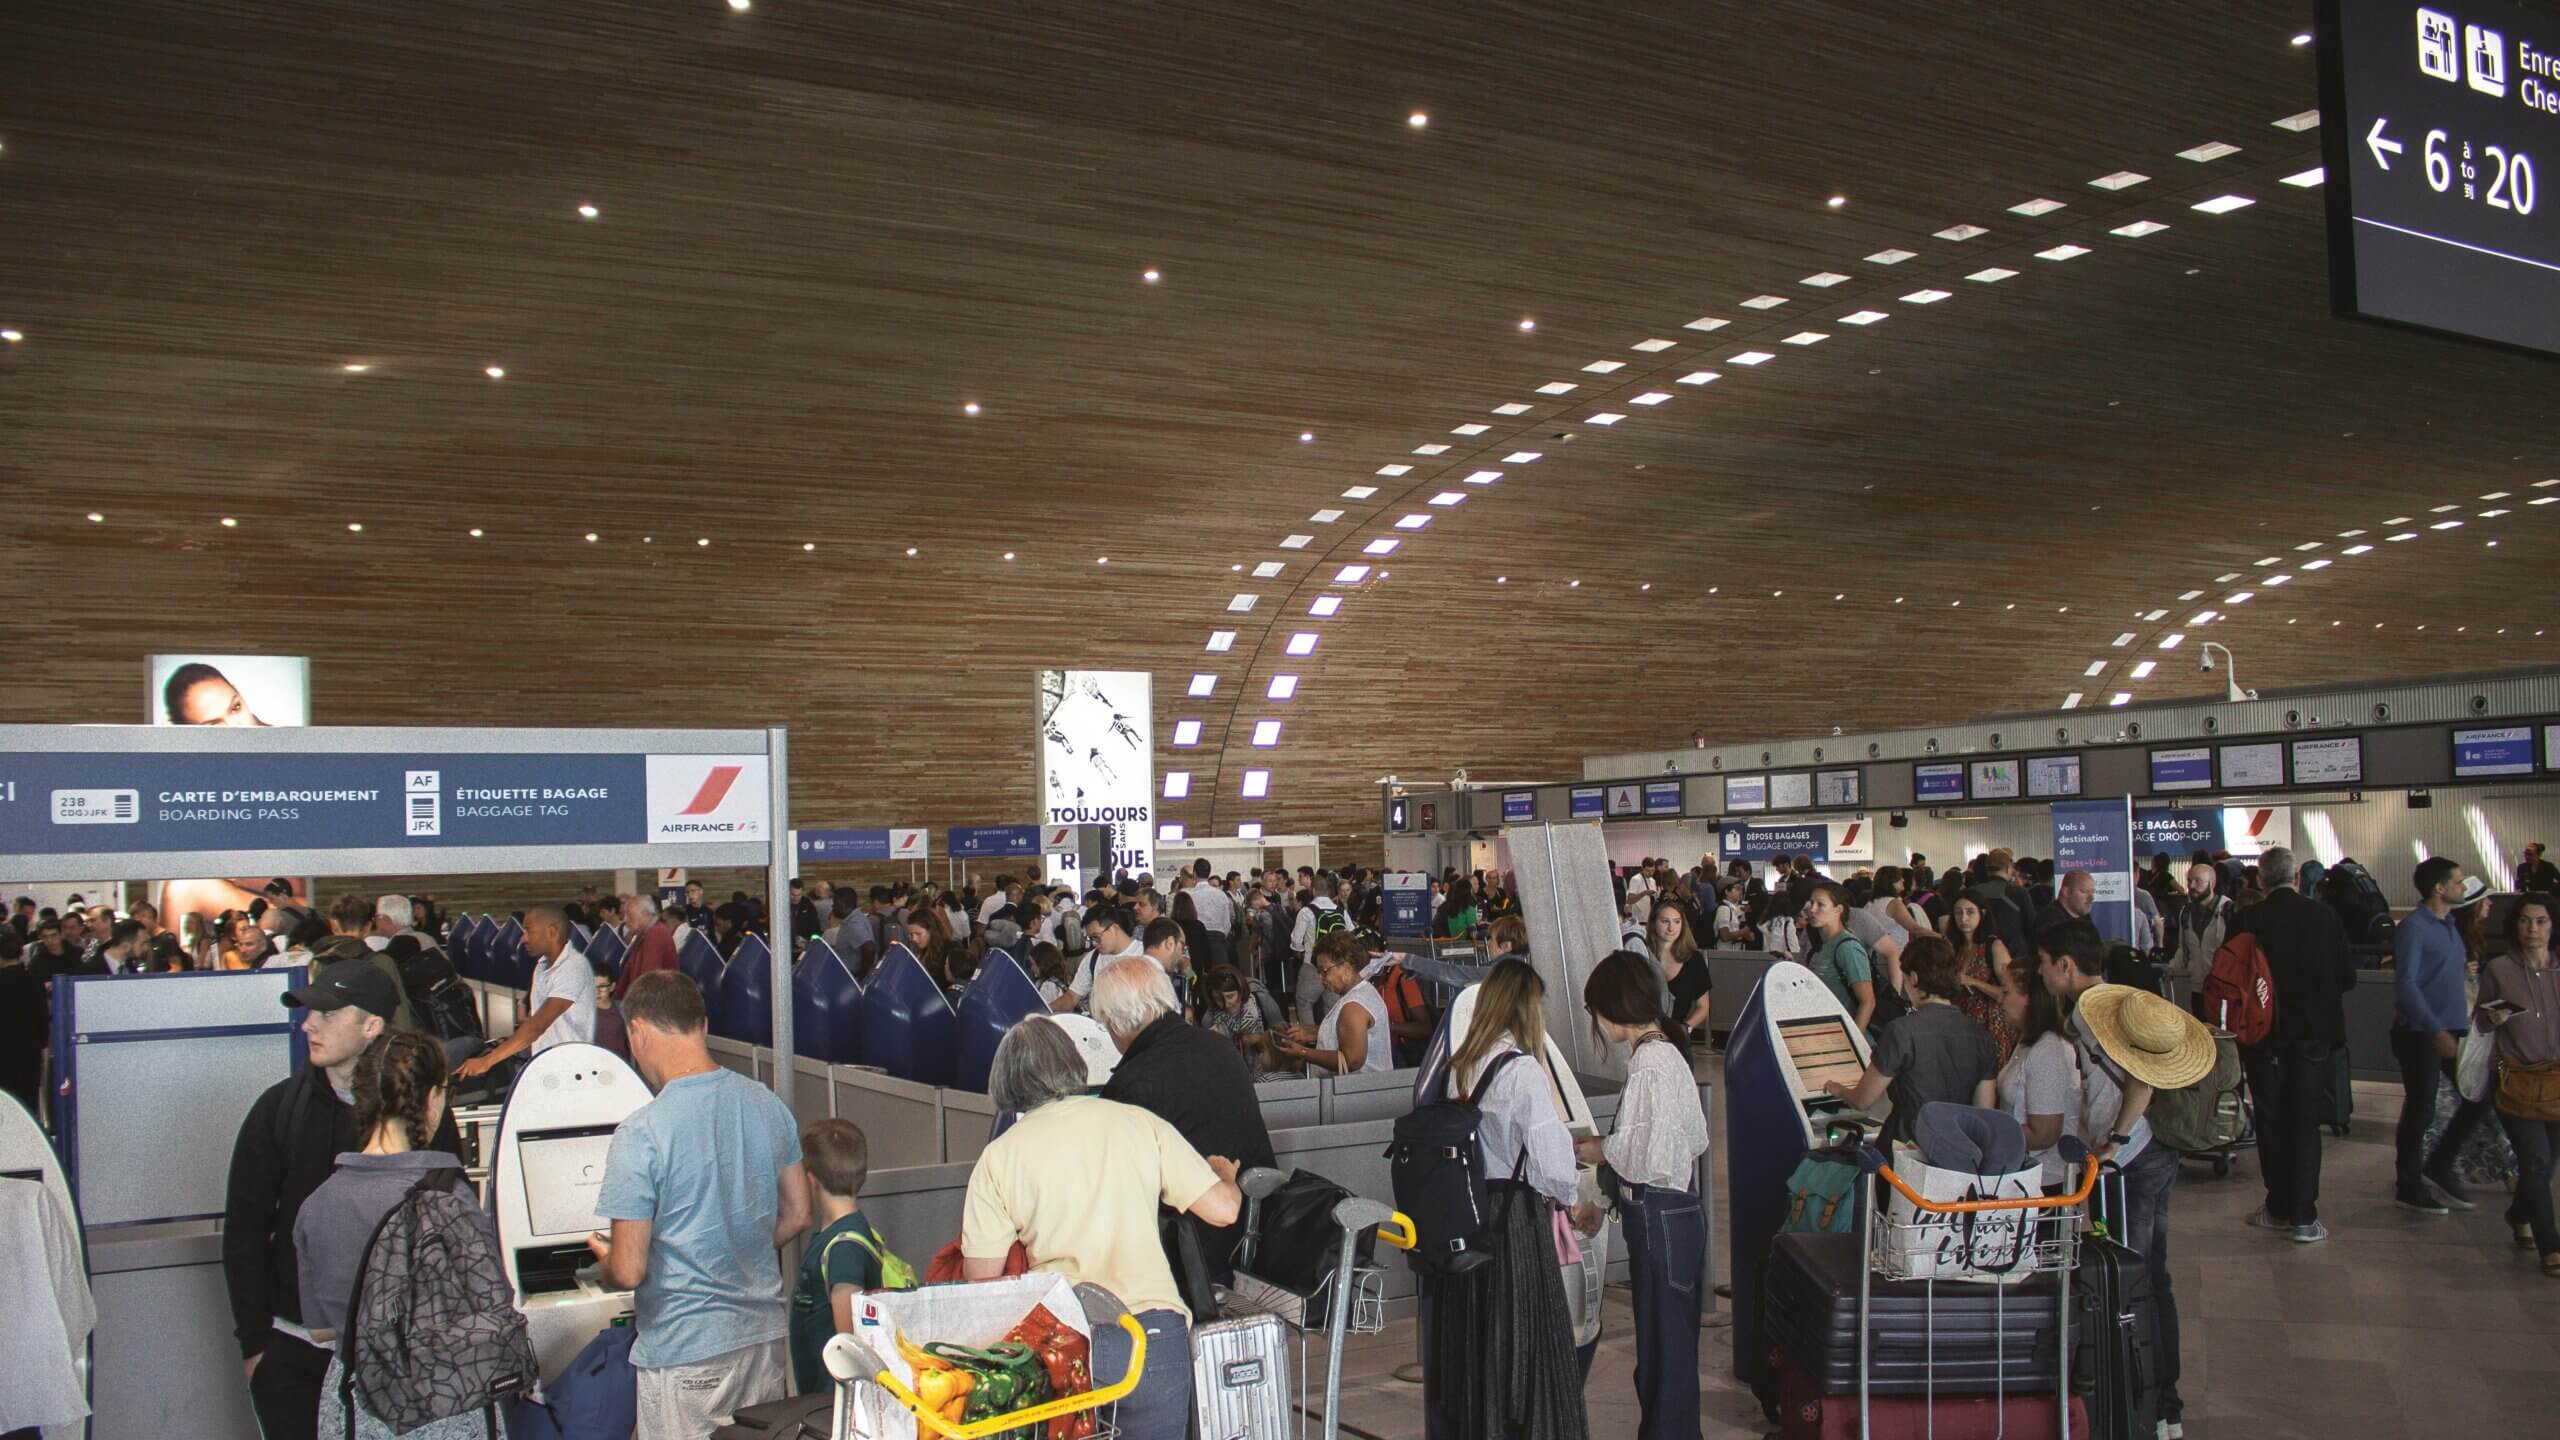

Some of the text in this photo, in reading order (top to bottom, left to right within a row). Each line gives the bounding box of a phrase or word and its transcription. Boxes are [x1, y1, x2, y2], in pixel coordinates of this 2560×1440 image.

[2521, 79, 2560, 114] Che
[2424, 129, 2534, 216] 6 20
[2460, 161, 2474, 179] to
[412, 775, 433, 787] AF
[0, 781, 15, 802] I
[158, 790, 379, 803] CARTE D'EMBARQUEMENT
[456, 787, 608, 800] ÉTIQUETTE BAGAGE
[60, 797, 86, 807] 23B
[159, 808, 299, 821] BOARDING PASS
[456, 805, 569, 817] BAGGAGE TAG
[1050, 807, 1148, 822] TOUJOURS
[1393, 806, 1403, 825] 4
[412, 821, 434, 831] JFK
[661, 823, 734, 832] AIRFRANCE
[2058, 822, 2086, 832] Vols à
[2146, 820, 2198, 830] BAGAGES
[1746, 831, 1810, 841] DÉPOSE BAGAGES
[2058, 833, 2110, 844] destination
[2158, 831, 2212, 842] DROP-OFF
[1746, 841, 1820, 850] BAGGAGE DROP-OFF
[2059, 847, 2075, 856] des
